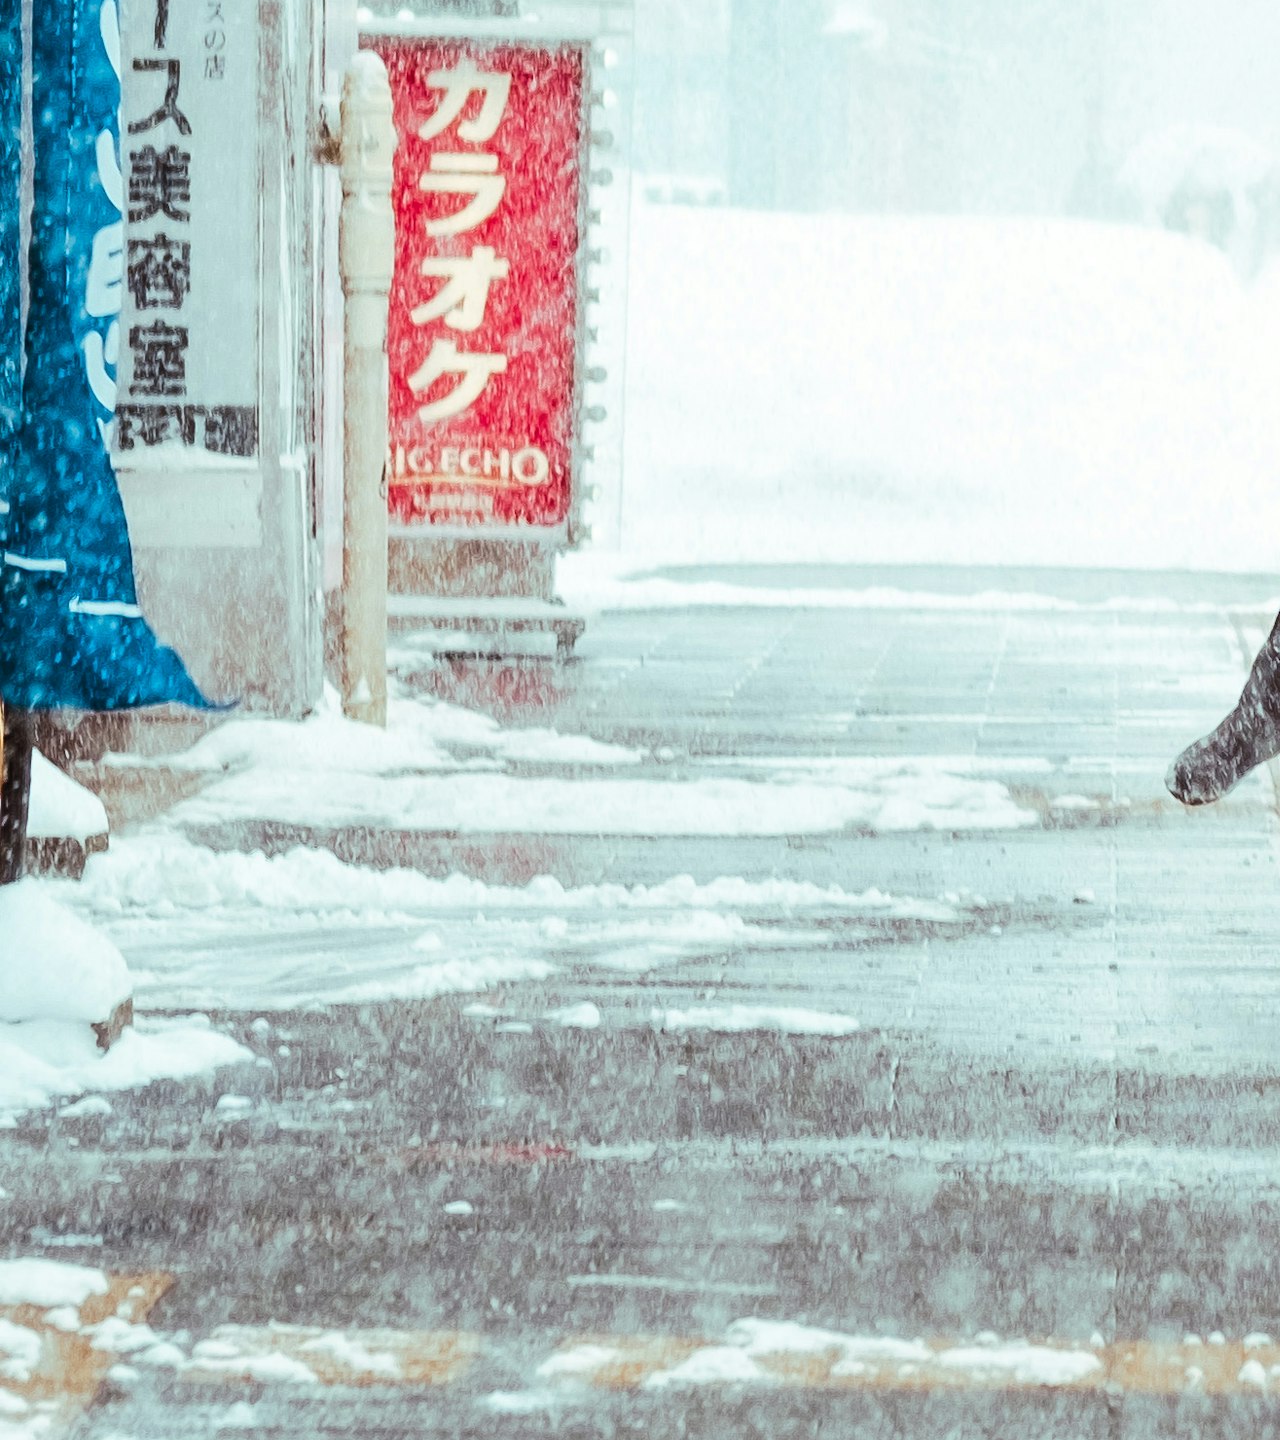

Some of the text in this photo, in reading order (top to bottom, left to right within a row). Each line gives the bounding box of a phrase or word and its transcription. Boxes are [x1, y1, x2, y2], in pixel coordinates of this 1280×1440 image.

[407, 56, 513, 423] カラオケ
[441, 447, 550, 487] ECHO
